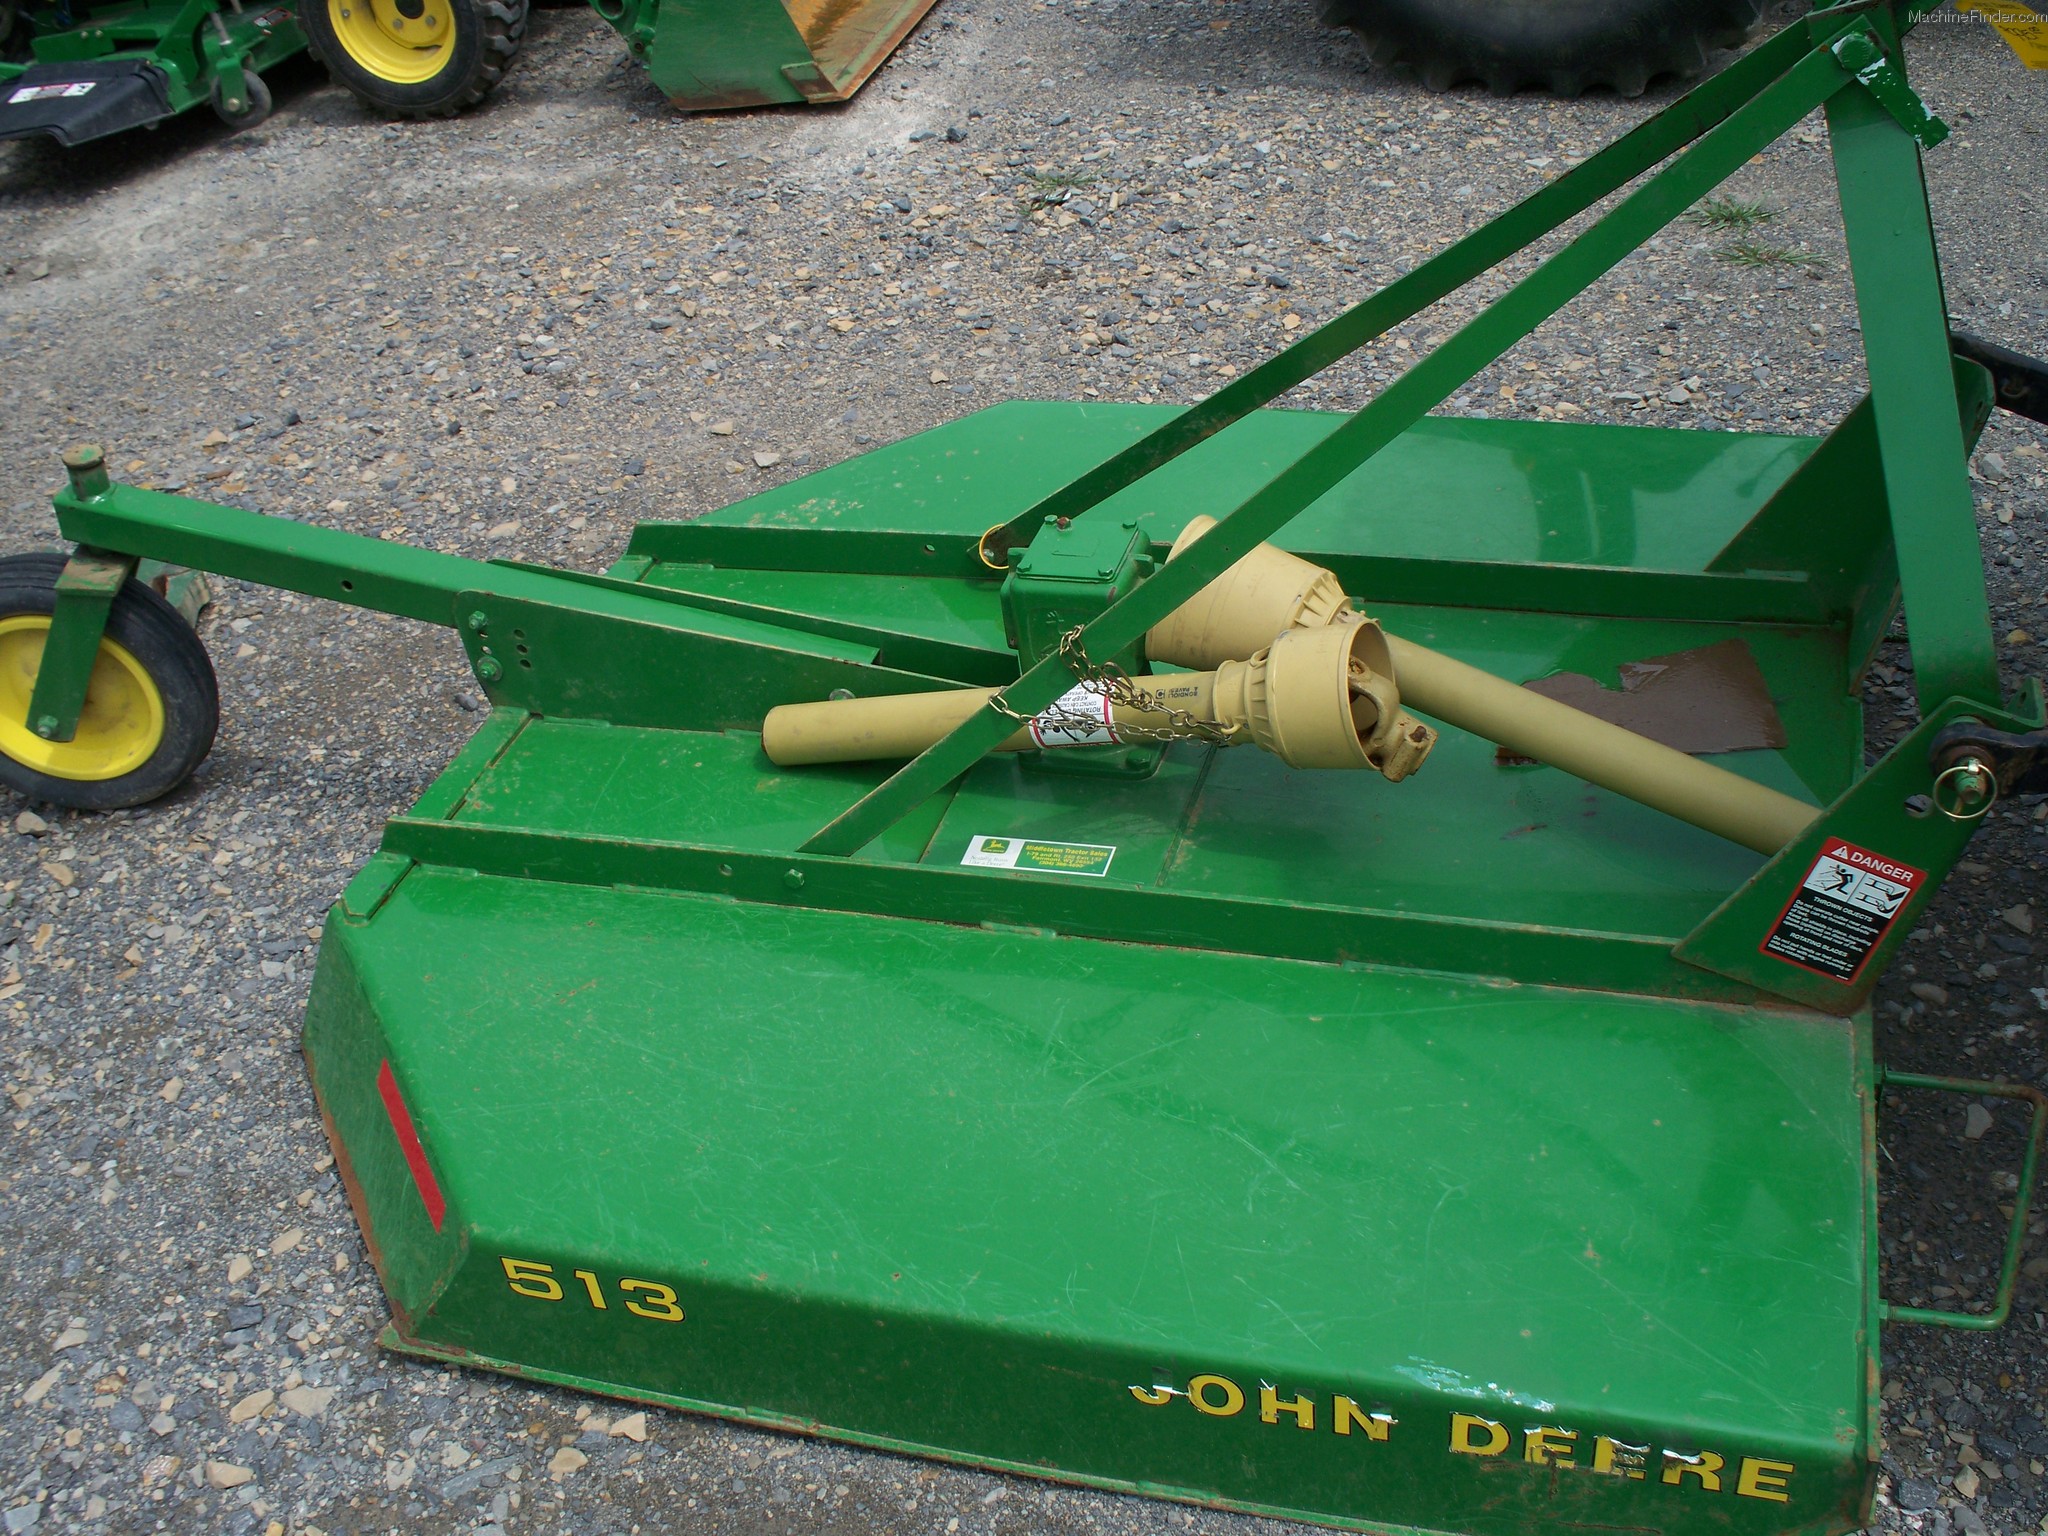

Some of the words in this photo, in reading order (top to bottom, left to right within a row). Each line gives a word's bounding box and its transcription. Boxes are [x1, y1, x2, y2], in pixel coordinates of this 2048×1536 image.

[1850, 851, 1914, 883] DANGER
[1814, 897, 1843, 911] THROWN
[1842, 908, 1873, 923] OBJECTS
[1790, 933, 1822, 948] ROTATING
[1821, 945, 1848, 957] BLADES
[500, 1256, 686, 1323] 513
[1128, 1373, 1393, 1442] JOHN
[1449, 1411, 1796, 1501] DEERE
